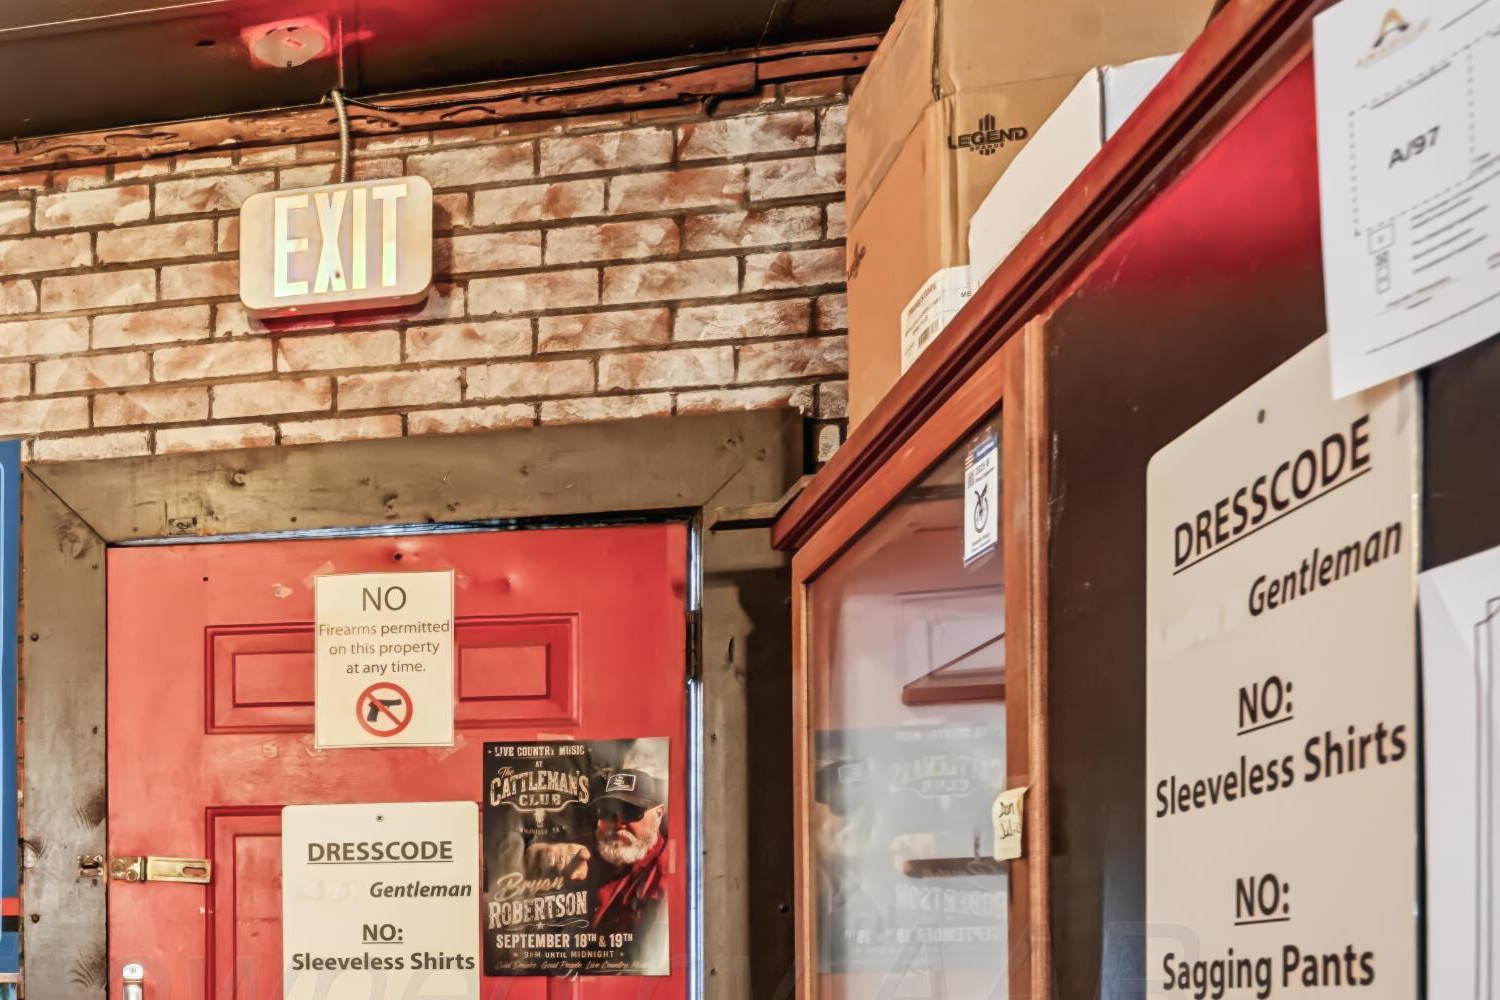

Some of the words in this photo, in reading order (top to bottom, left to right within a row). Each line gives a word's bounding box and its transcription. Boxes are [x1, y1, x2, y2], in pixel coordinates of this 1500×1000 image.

[947, 127, 1029, 150] LEGEND
[273, 183, 408, 298] EXIT
[1174, 413, 1371, 570] DRESSCODE
[1248, 521, 1402, 617] Gentleman
[362, 585, 407, 612] NO
[319, 623, 377, 637] Firearms
[380, 619, 451, 638] permitted
[328, 644, 347, 656] on
[351, 642, 376, 655] this
[379, 640, 441, 656] property
[346, 662, 360, 674] at
[362, 662, 388, 676] any
[391, 660, 427, 673] time.
[1238, 675, 1294, 730] NO:
[494, 746, 515, 757] LIVE
[517, 745, 555, 757] COUNTRY
[558, 744, 585, 756] MUSIC
[1155, 754, 1295, 818] Sleeveless
[1303, 722, 1407, 783] Shirts
[489, 770, 591, 807] CATTLEMAN'S
[519, 793, 562, 807] CLUB
[306, 840, 454, 863] DRESSCODE
[369, 880, 473, 898] Gentleman
[494, 871, 565, 901] Bryan
[1234, 873, 1290, 920] NO:
[488, 890, 589, 930] ROBERTSON
[361, 923, 404, 943] NO:
[495, 933, 570, 949] SEPTEMBER
[574, 932, 597, 949] 18TH
[598, 935, 607, 948] &
[609, 932, 634, 949] 19TH
[291, 952, 405, 971] Sleeveless
[410, 951, 476, 971] Shirts
[545, 951, 567, 959] UNTIL
[570, 950, 616, 958] MIDNIGHT
[1162, 946, 1273, 1000] Sagging
[1281, 944, 1376, 988] Pants
